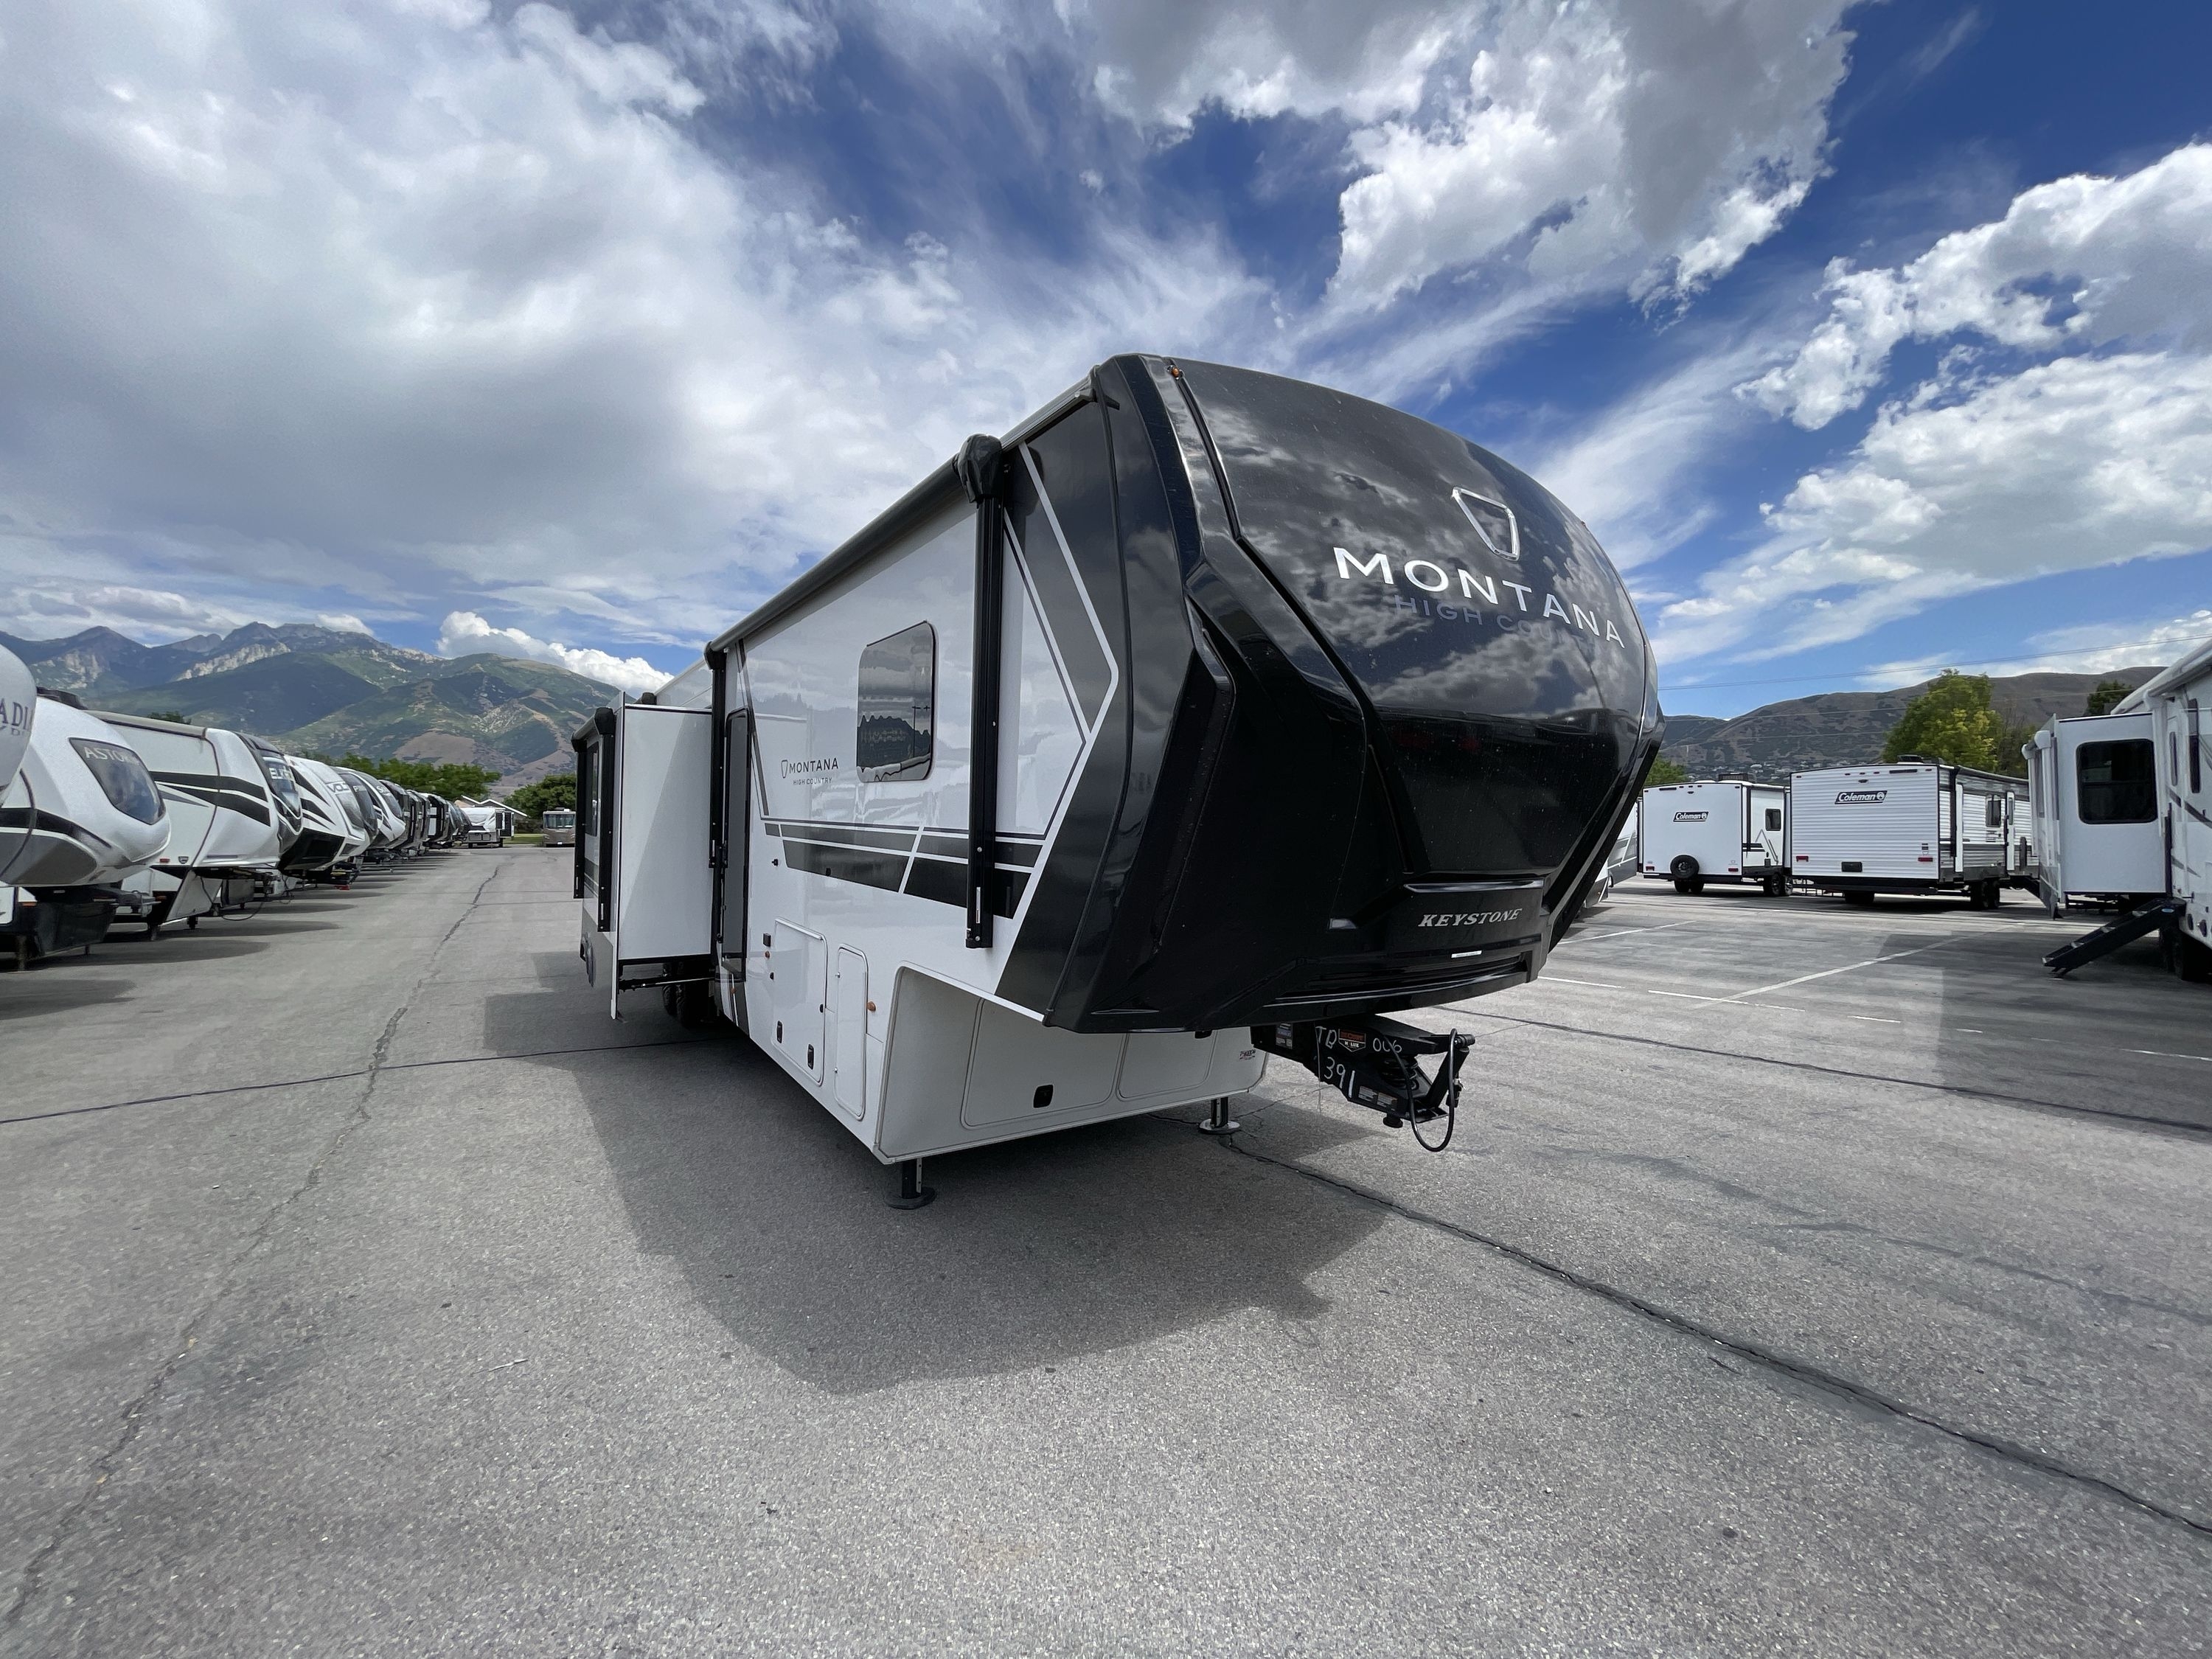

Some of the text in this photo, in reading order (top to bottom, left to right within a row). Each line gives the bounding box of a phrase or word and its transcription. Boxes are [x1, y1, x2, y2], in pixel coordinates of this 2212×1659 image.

[1333, 546, 1625, 649] MONTANA
[1394, 594, 1483, 626] HIGH
[789, 757, 838, 773] MONTANA
[807, 777, 832, 785] COUNTRY
[1837, 791, 1877, 801] Coleman
[1675, 812, 1702, 821] Coleman
[1418, 908, 1523, 927] KEYSTONE
[1324, 1057, 1355, 1099] 391
